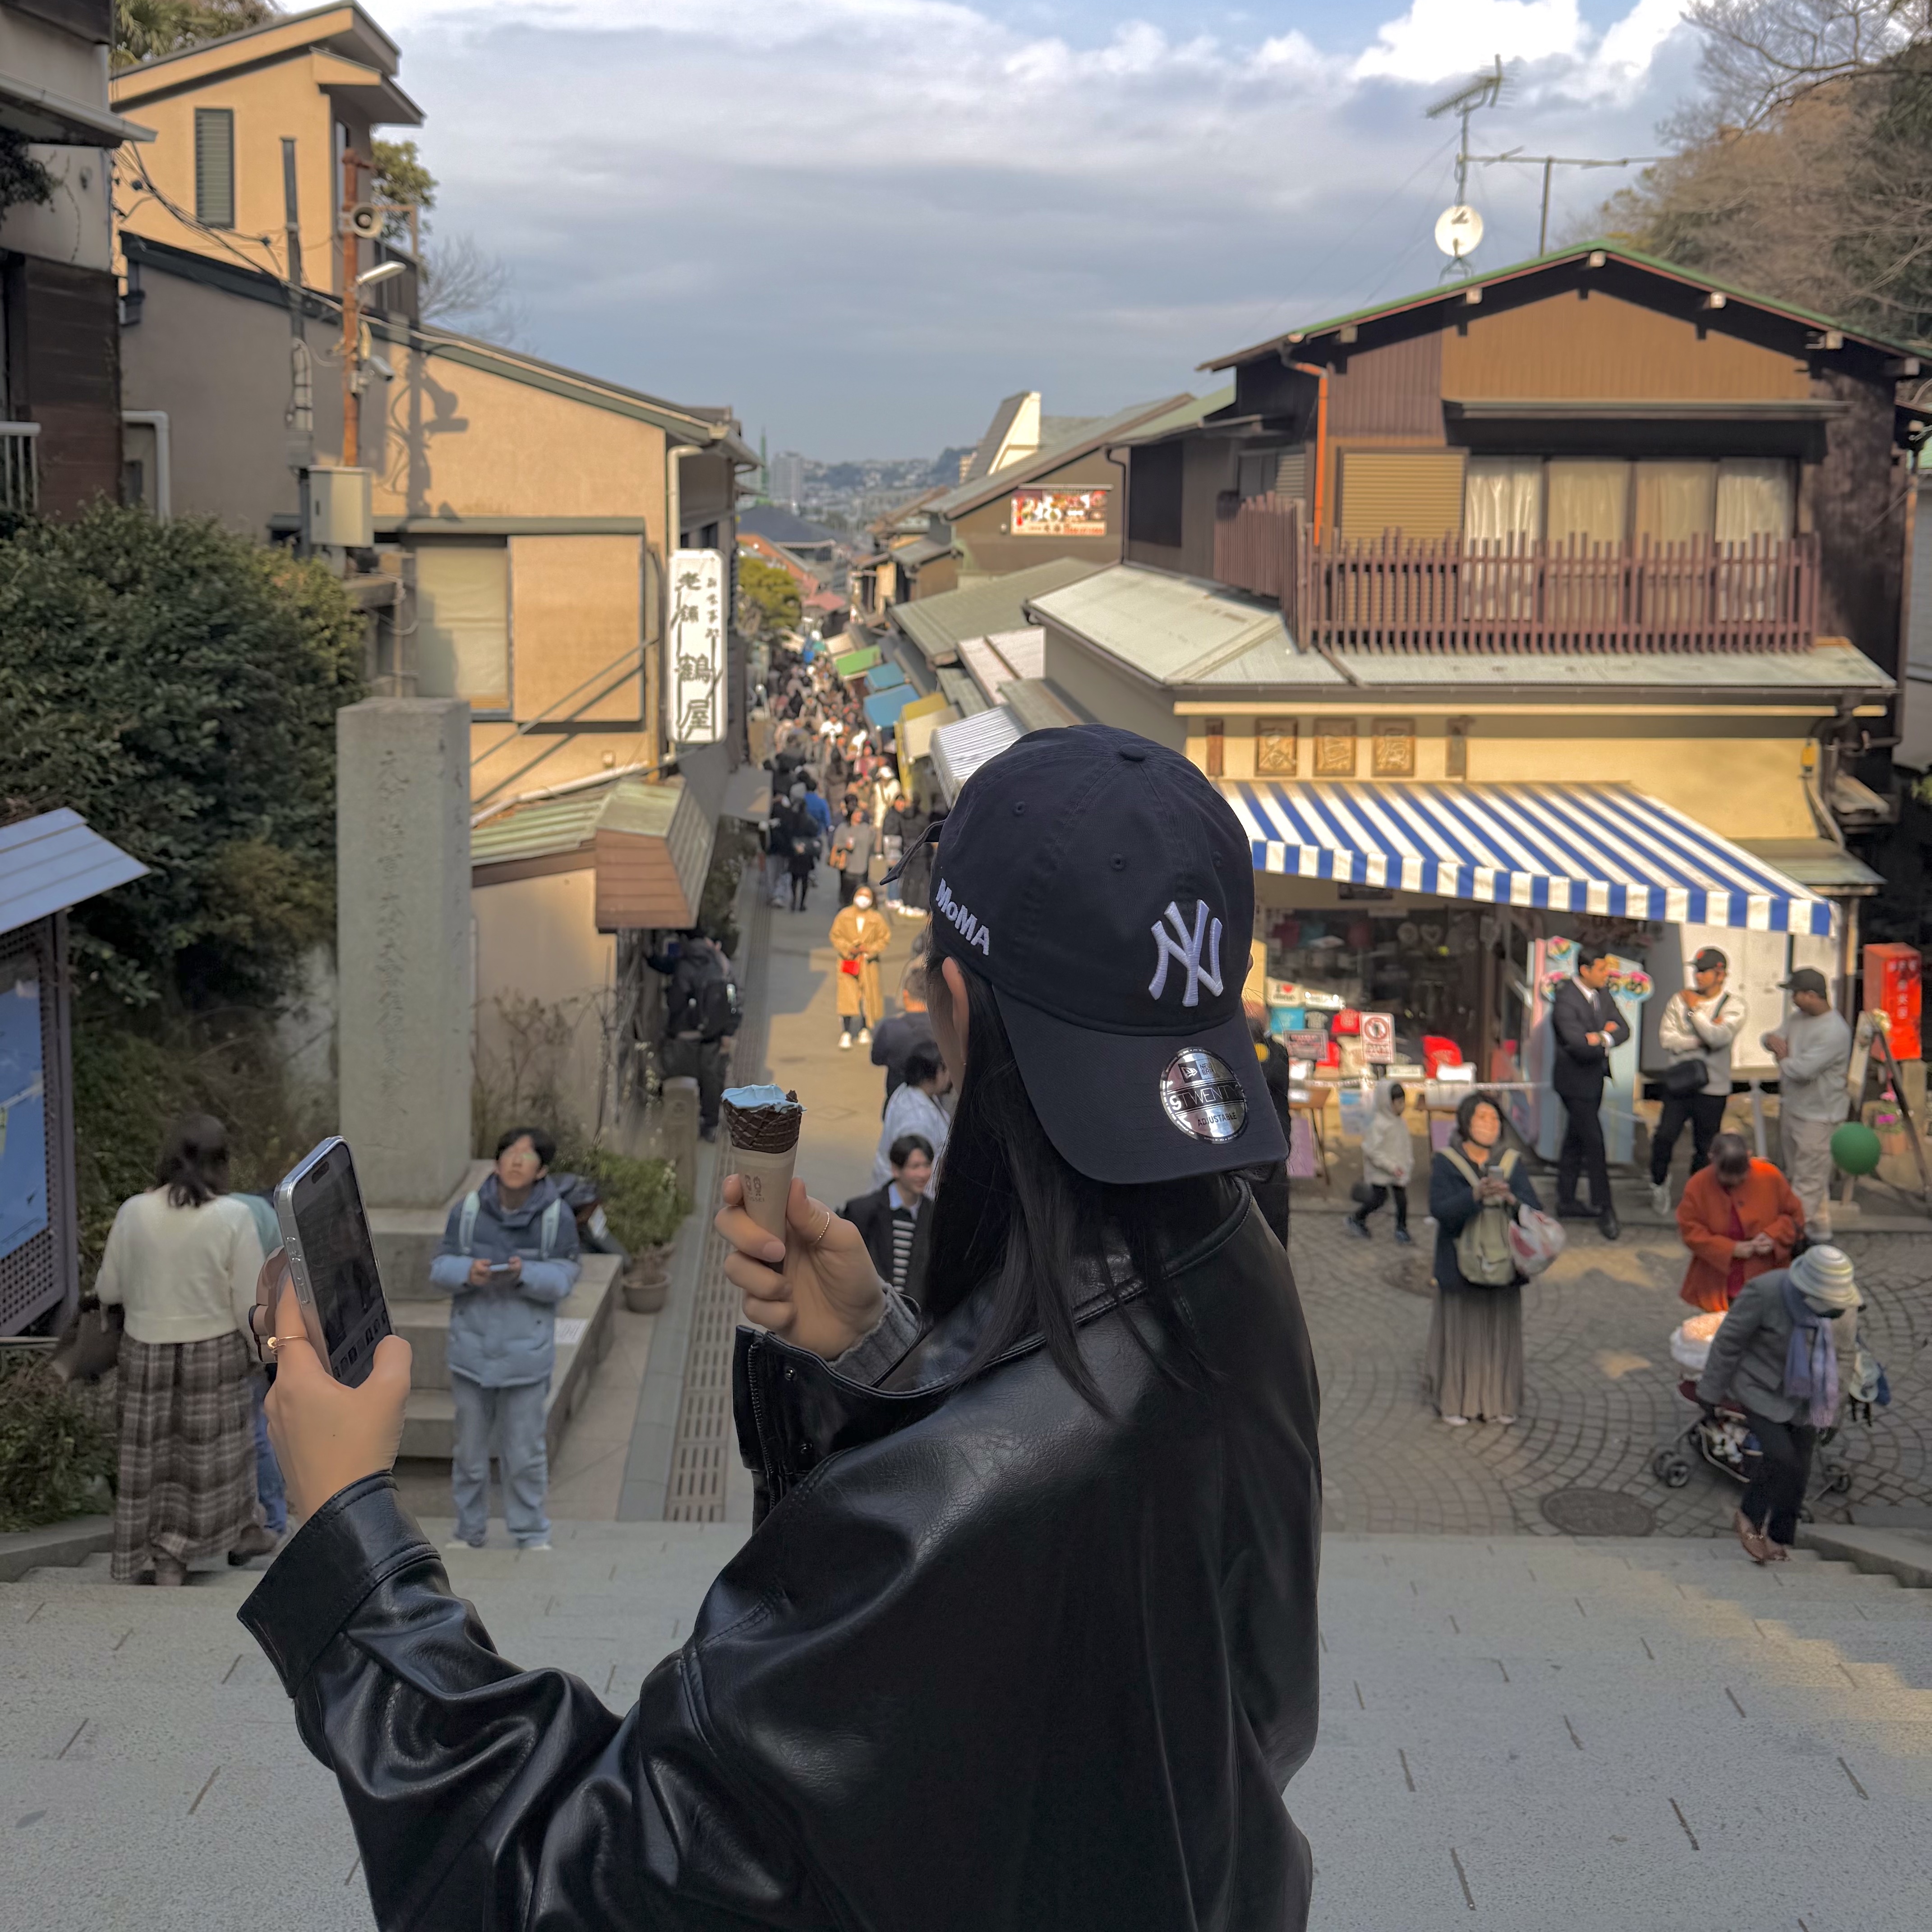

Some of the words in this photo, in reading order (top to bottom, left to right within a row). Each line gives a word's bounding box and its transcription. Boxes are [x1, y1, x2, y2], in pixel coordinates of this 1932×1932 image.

[935, 878, 990, 956] MoMA
[1148, 899, 1223, 1007] NY
[1198, 1112, 1237, 1127] ADJUSTABLE
